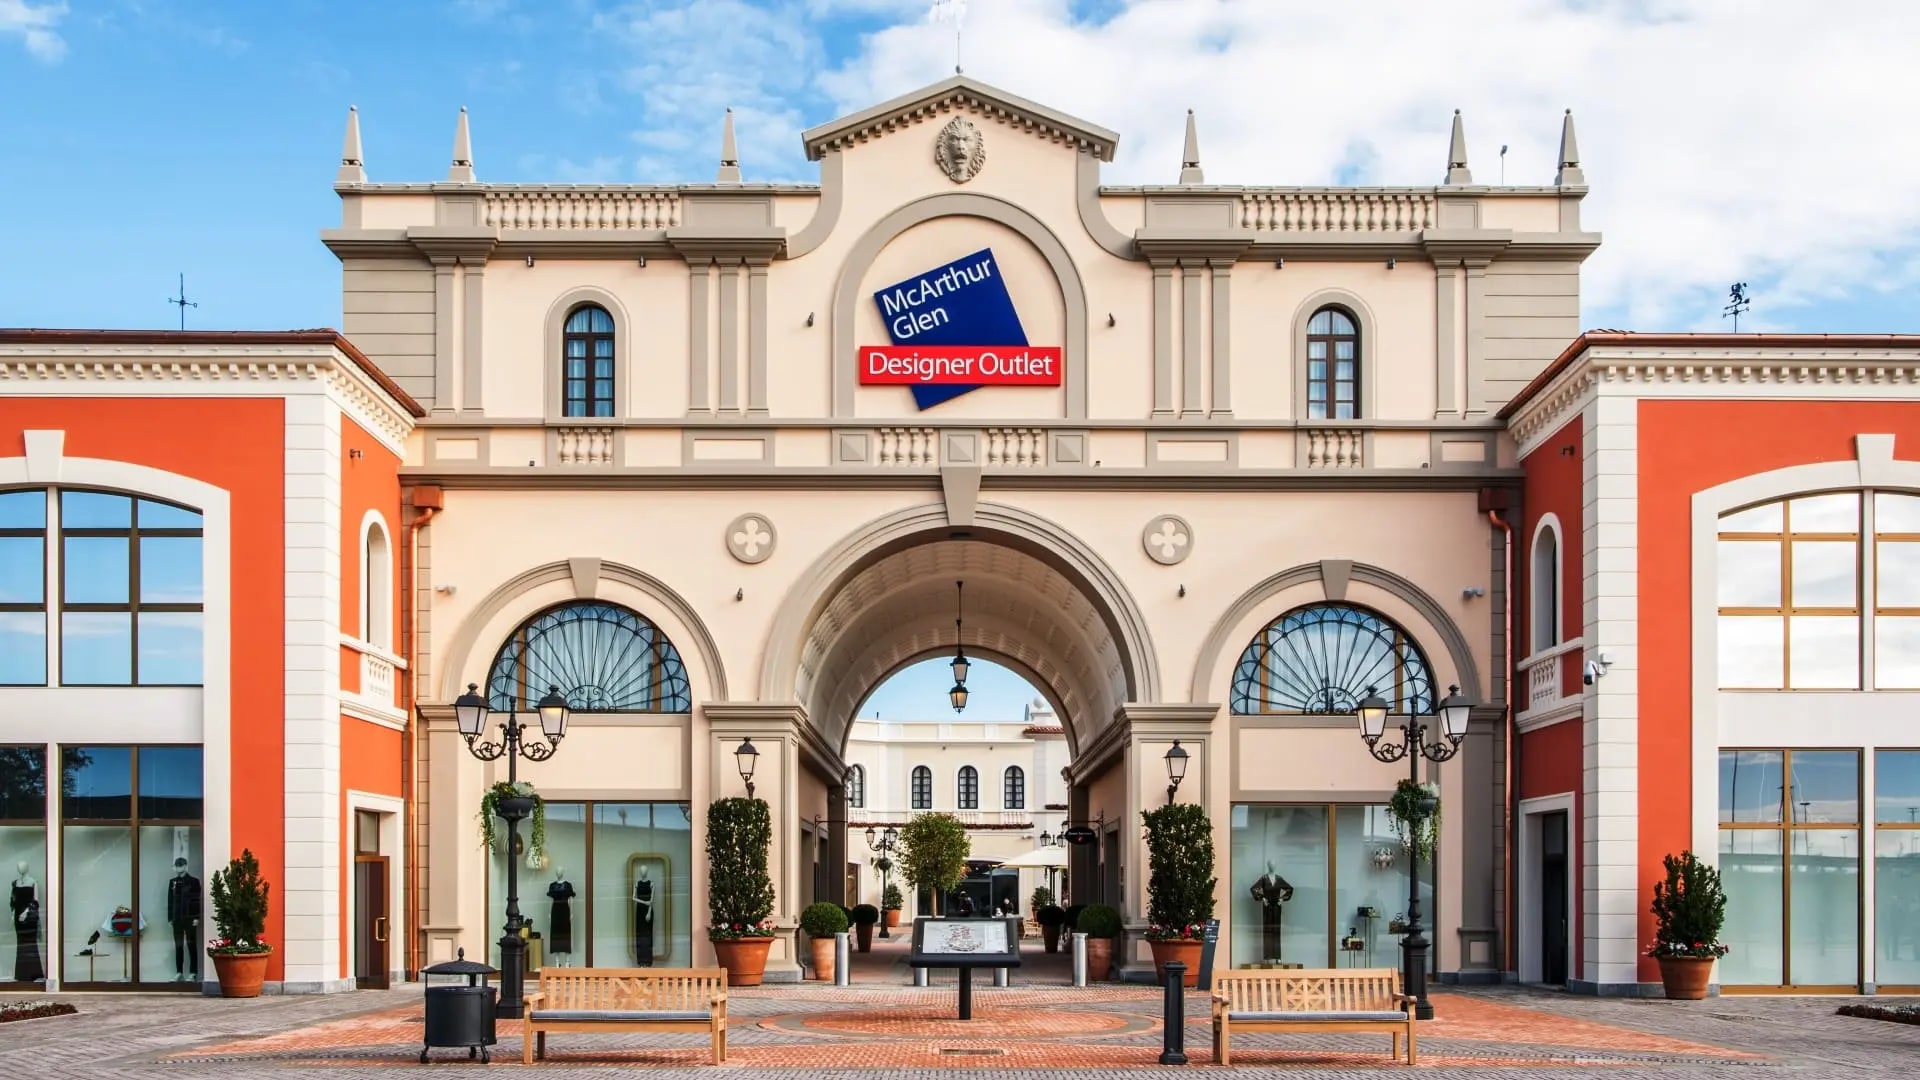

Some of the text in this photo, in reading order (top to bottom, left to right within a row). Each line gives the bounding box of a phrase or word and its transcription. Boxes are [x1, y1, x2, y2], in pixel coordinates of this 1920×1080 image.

[882, 259, 991, 316] McArthur
[893, 307, 949, 339] Glen
[869, 352, 1053, 381] Designer Outlet
